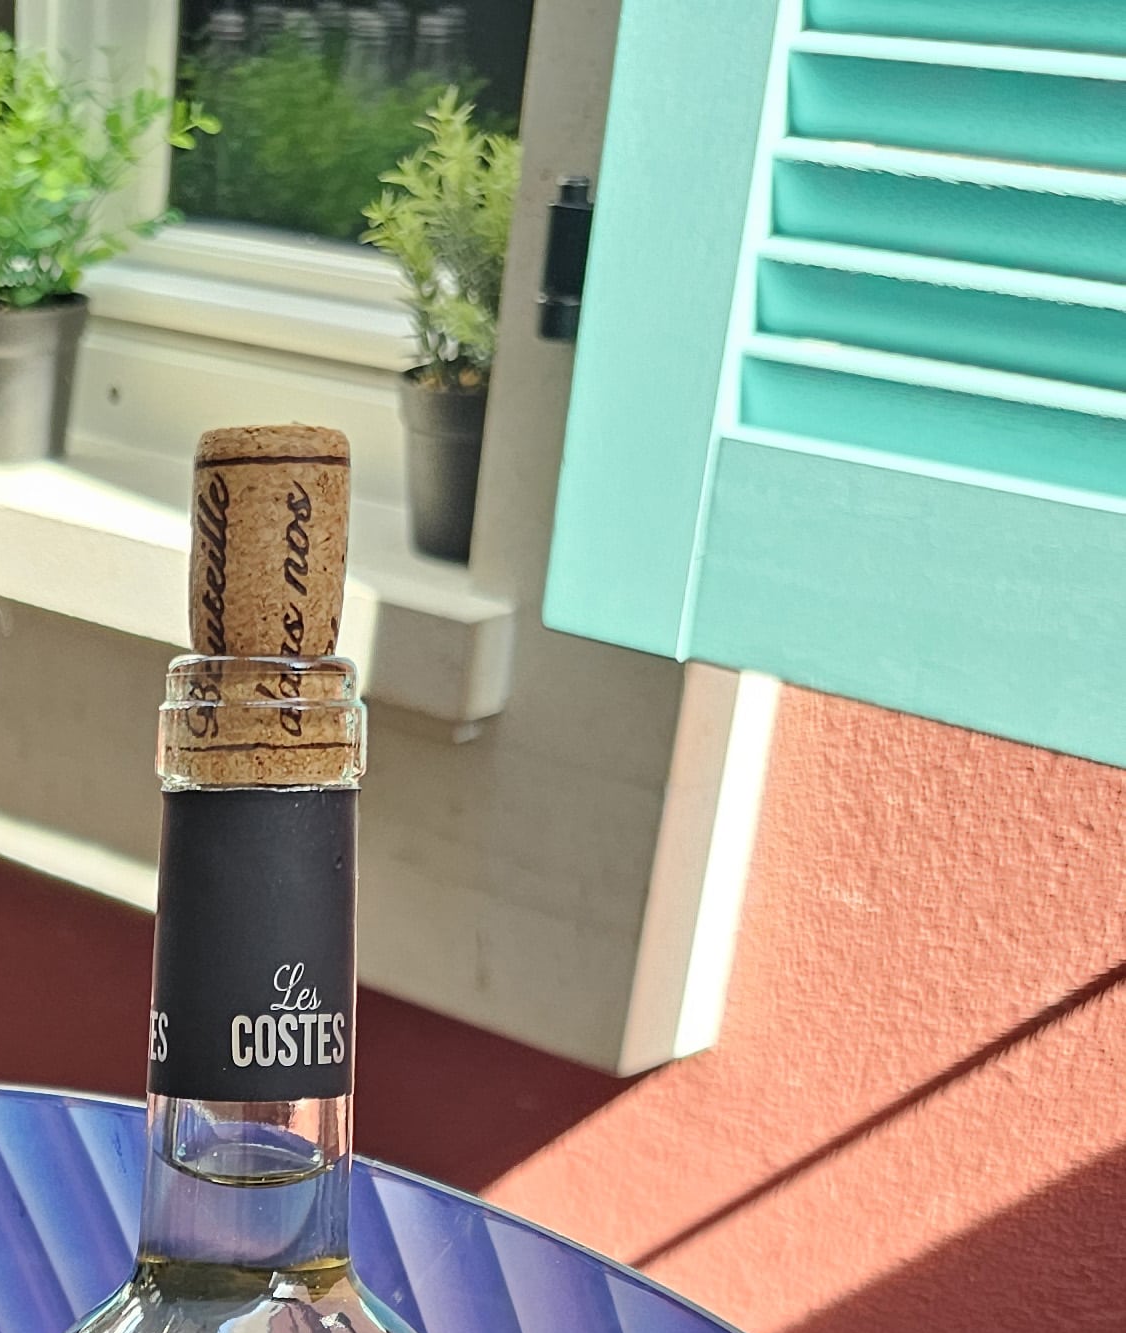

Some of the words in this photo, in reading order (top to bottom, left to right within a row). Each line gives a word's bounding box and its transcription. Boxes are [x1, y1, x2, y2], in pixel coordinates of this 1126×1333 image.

[283, 481, 315, 597] nos
[270, 962, 322, 1012] Les
[231, 1011, 346, 1068] COSTES
